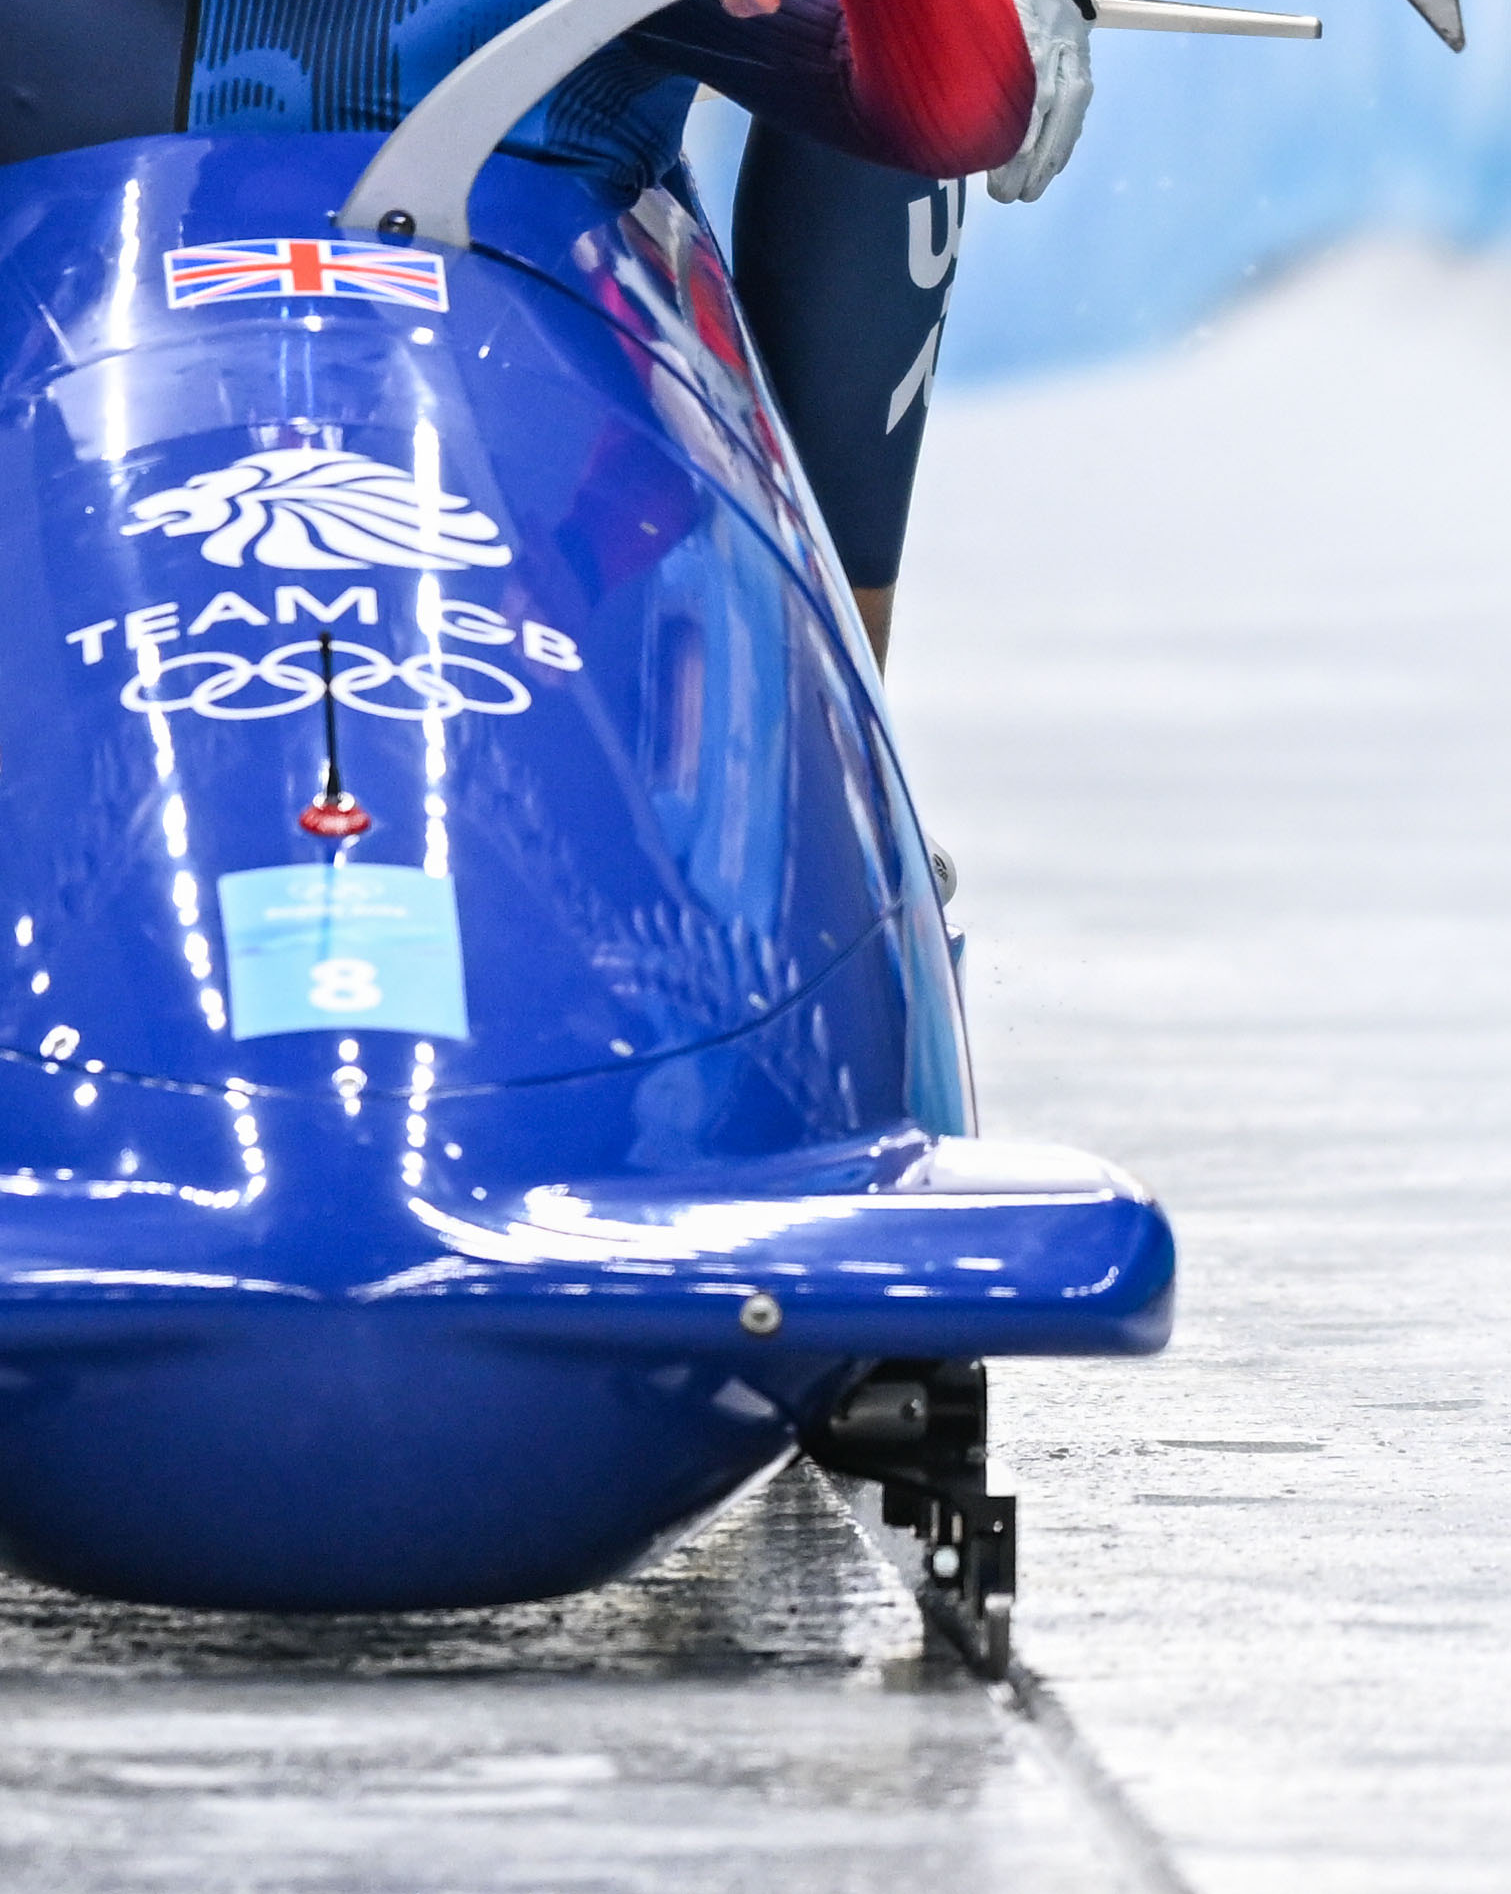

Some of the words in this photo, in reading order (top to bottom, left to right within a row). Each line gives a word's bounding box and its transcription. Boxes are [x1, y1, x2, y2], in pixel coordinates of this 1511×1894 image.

[66, 585, 379, 666] TEAM
[418, 598, 584, 672] GB
[308, 957, 383, 1013] 8
